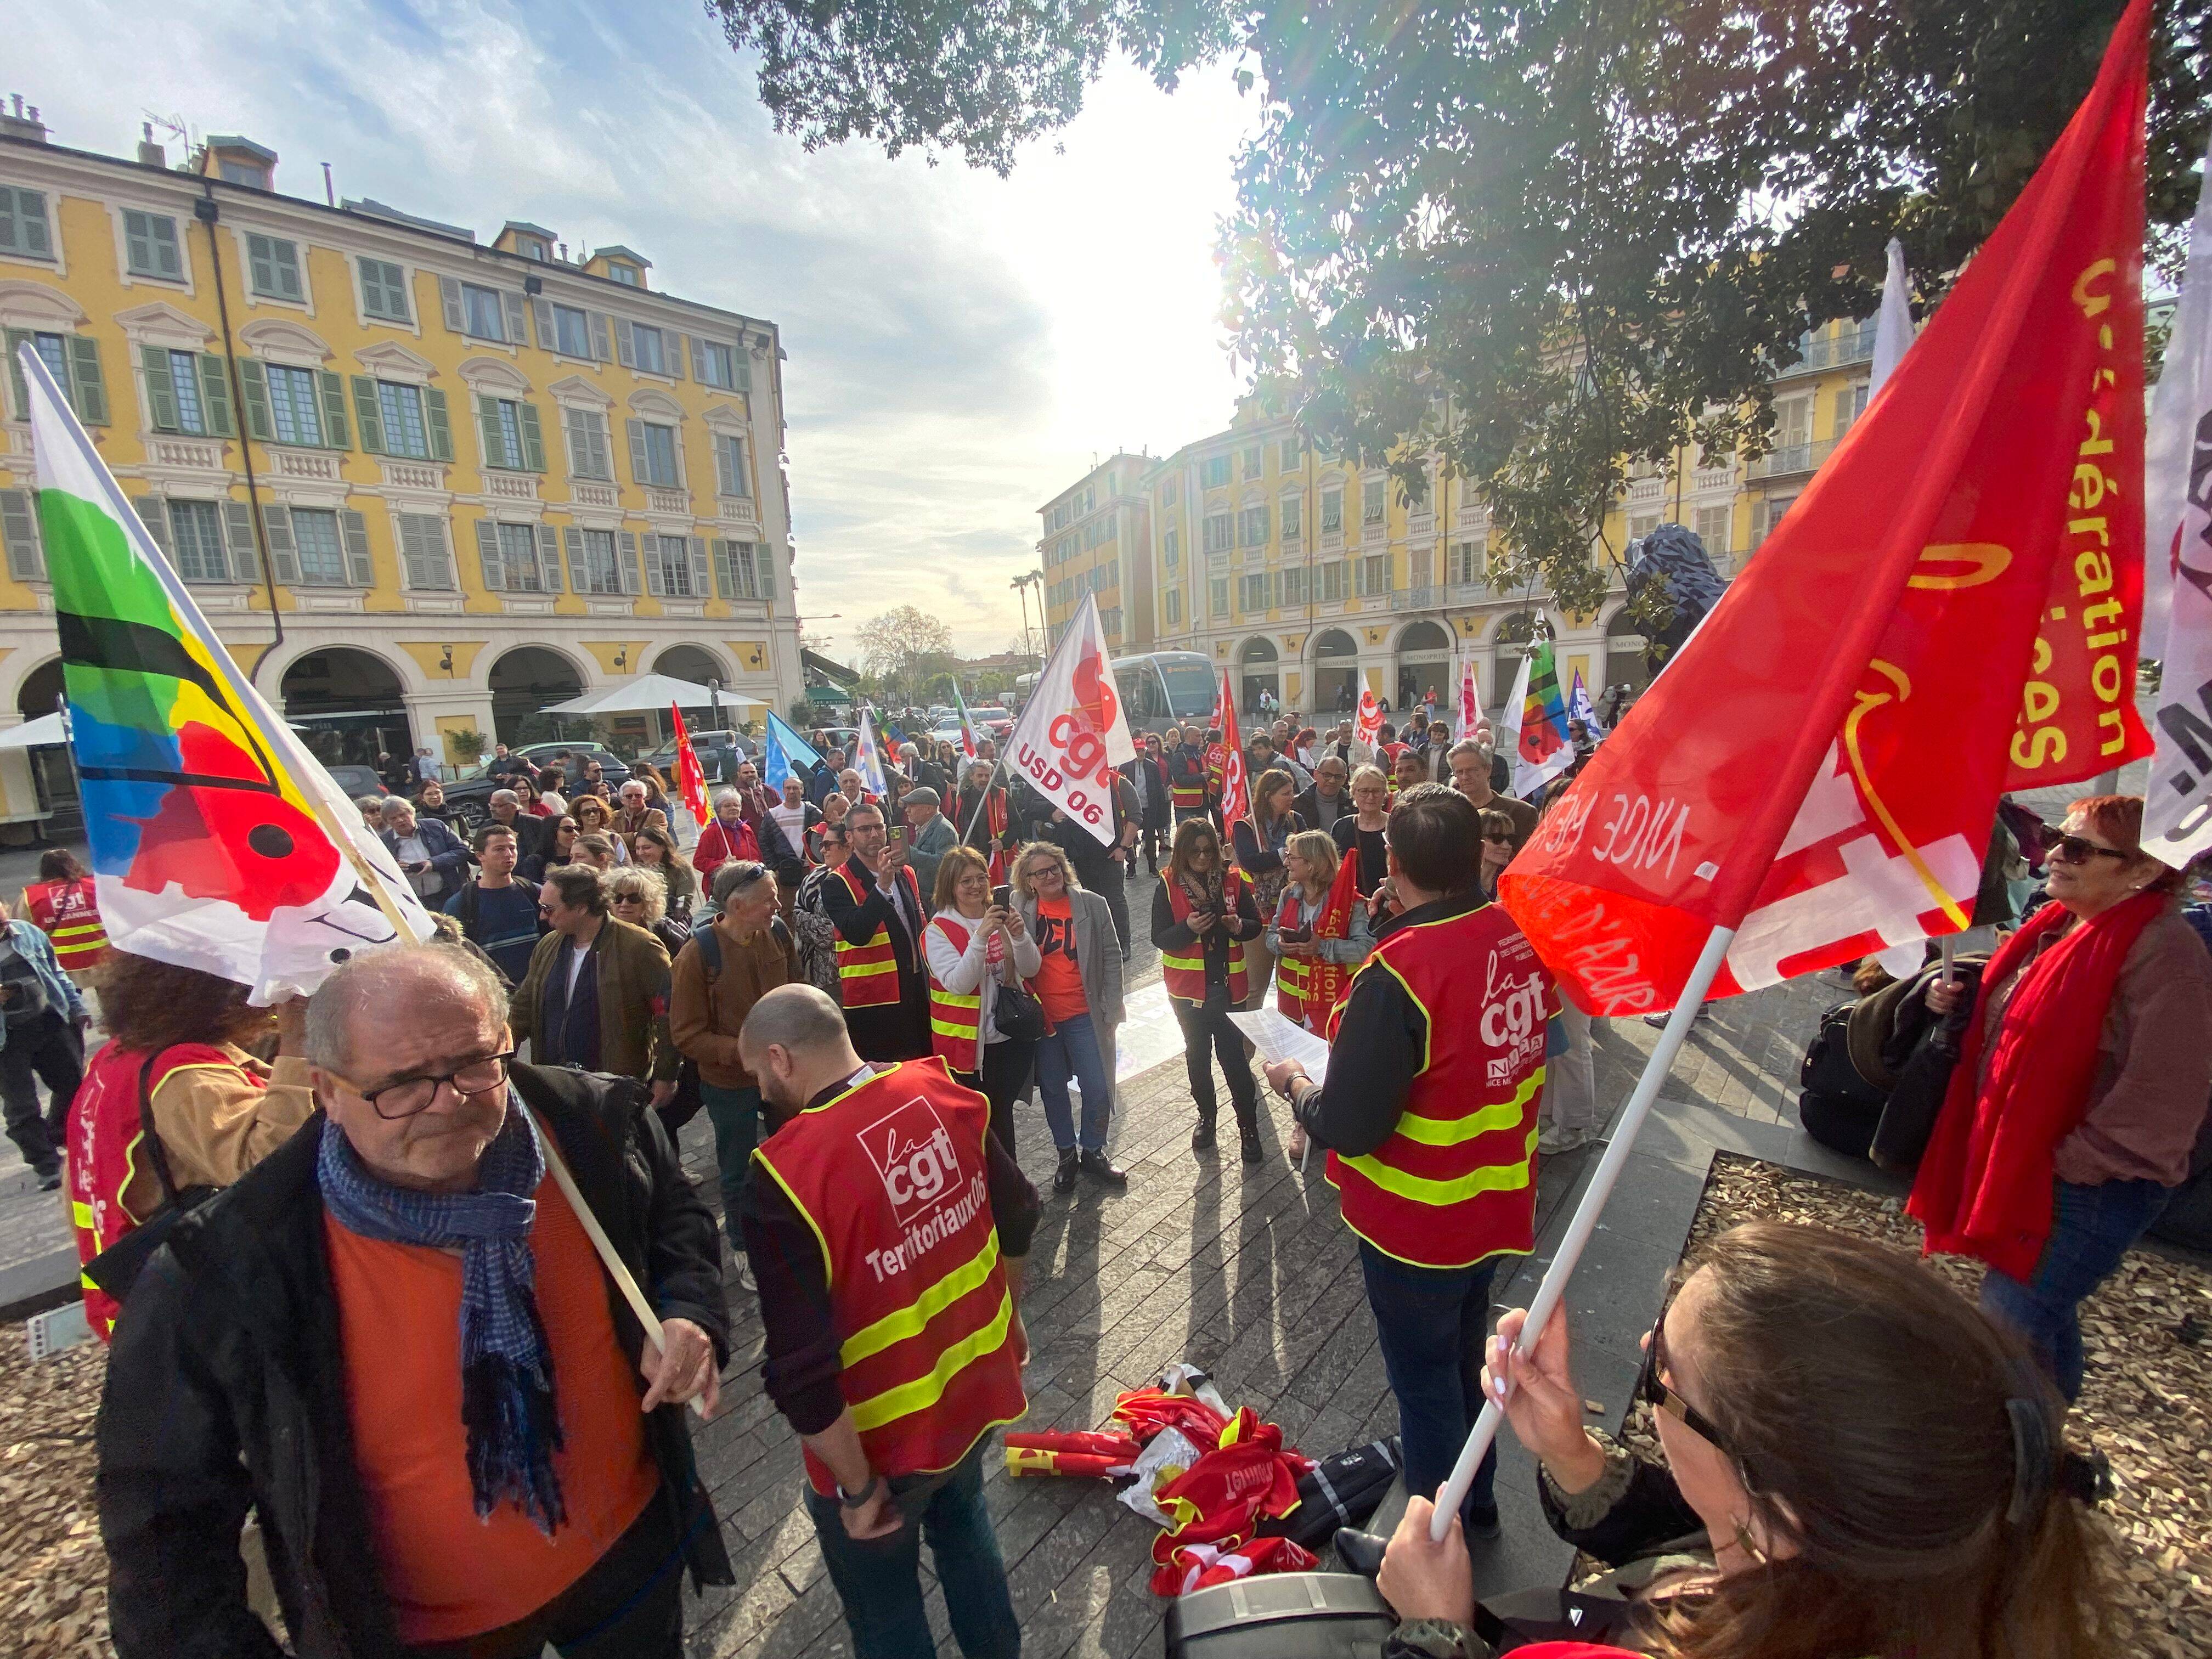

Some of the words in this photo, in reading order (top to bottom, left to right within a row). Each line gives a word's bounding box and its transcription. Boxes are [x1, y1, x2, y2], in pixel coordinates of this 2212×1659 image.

[1407, 653, 1446, 661] MONOPRIX
[1019, 742, 1063, 791] USD
[1068, 791, 1104, 824] 06
[1481, 950, 1530, 1009] la
[1552, 904, 1656, 1015] D'AZUR
[1480, 971, 1548, 1047] cgt
[884, 1128, 934, 1174] la
[886, 1128, 958, 1205] cgt
